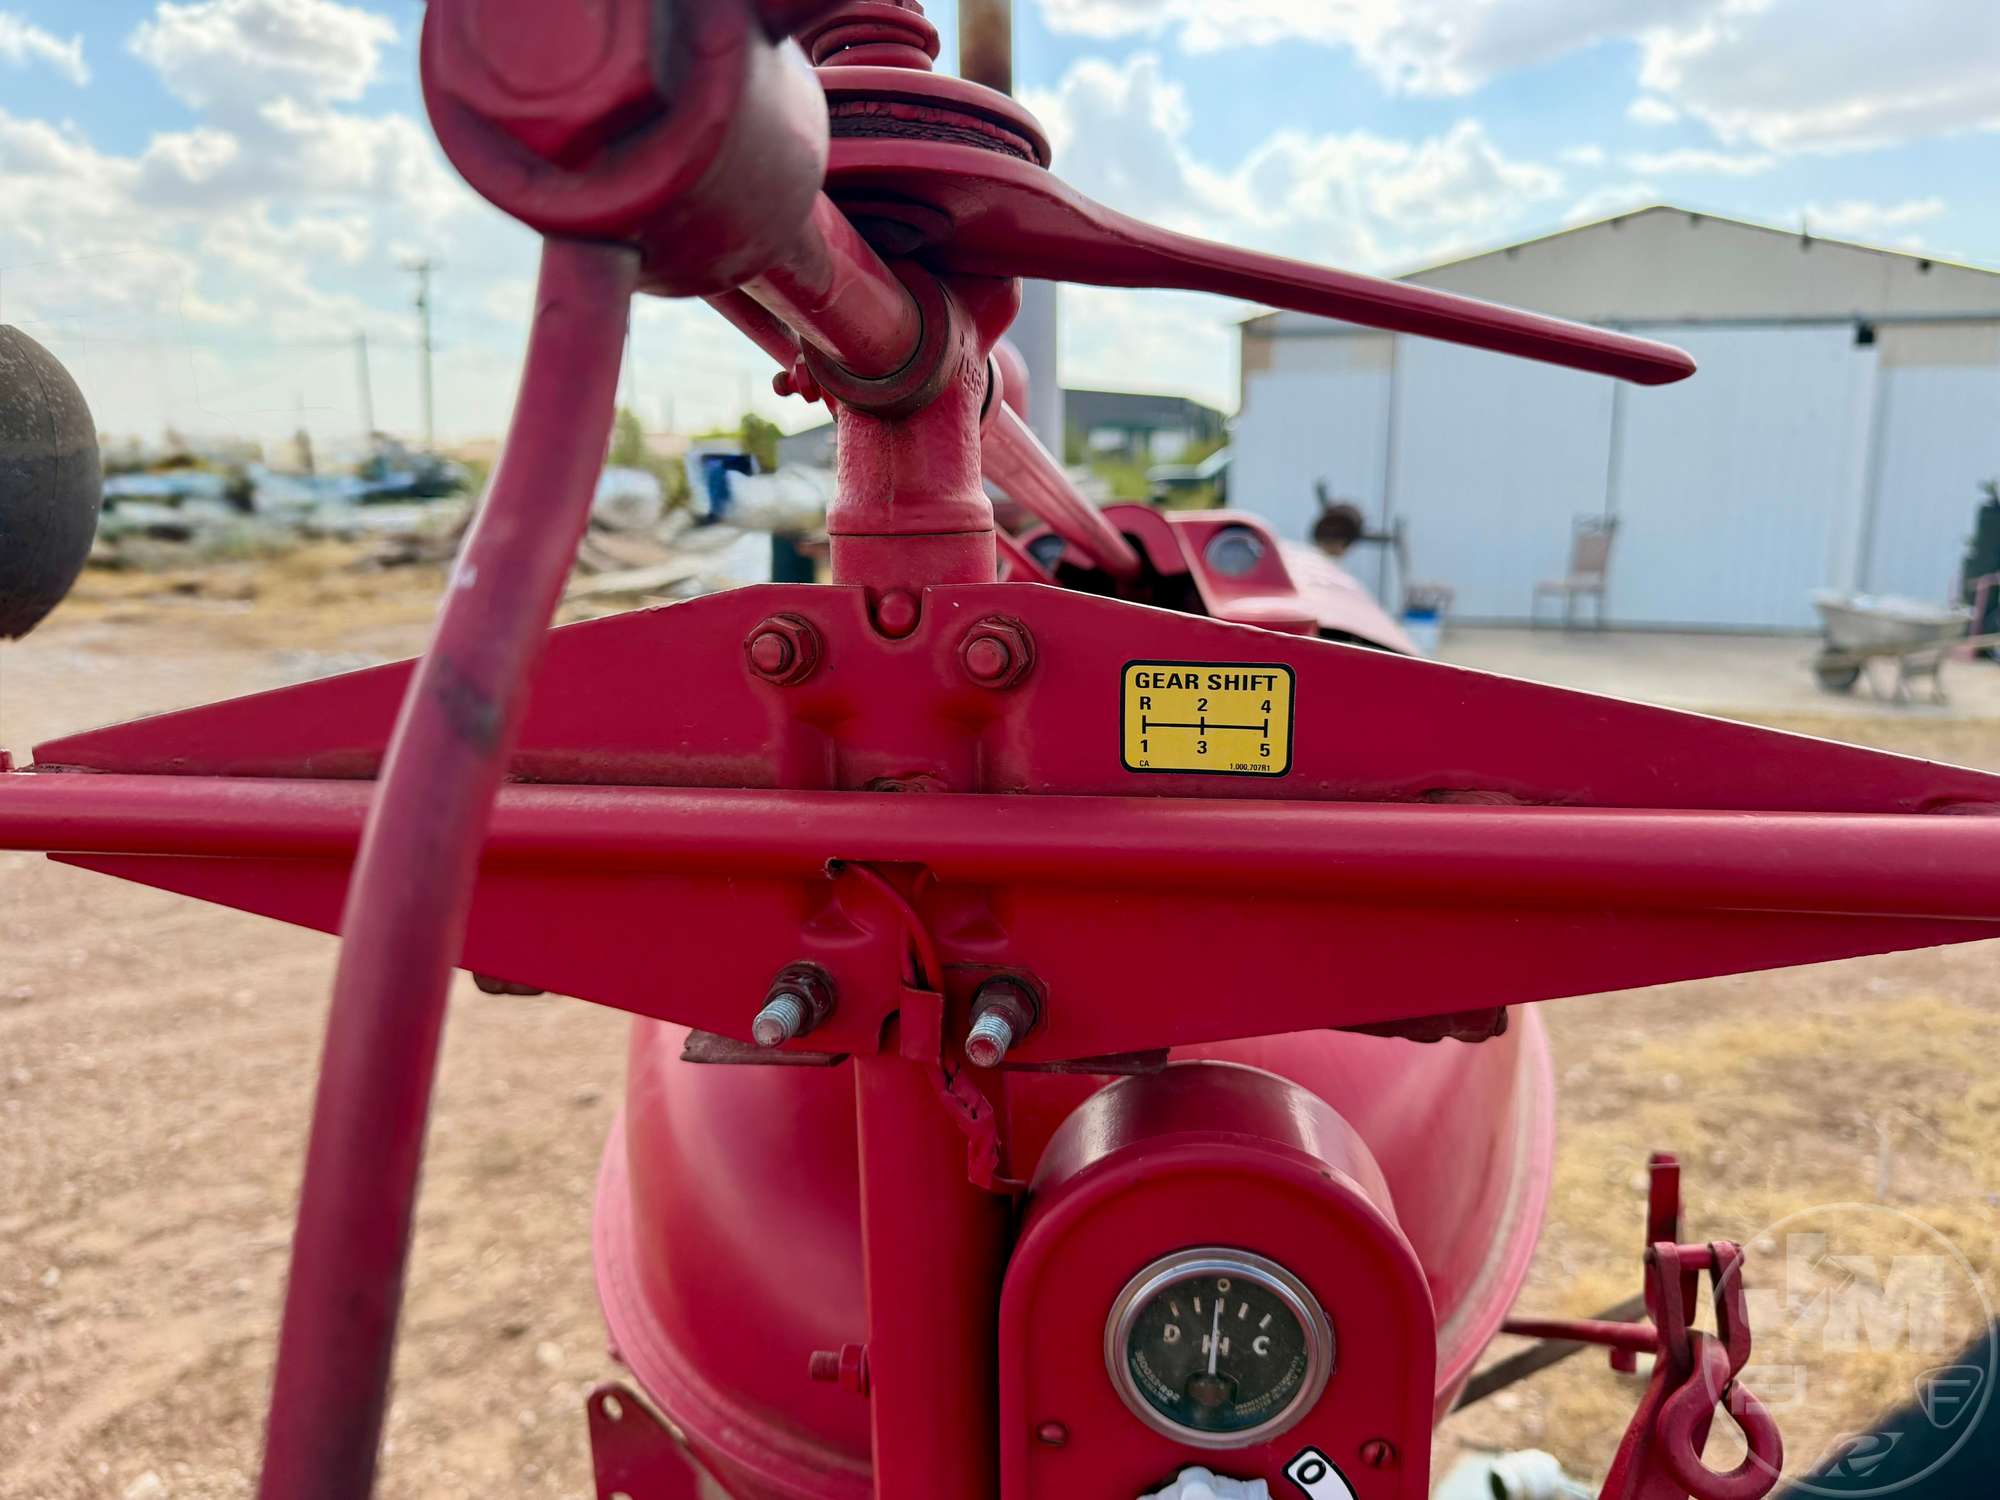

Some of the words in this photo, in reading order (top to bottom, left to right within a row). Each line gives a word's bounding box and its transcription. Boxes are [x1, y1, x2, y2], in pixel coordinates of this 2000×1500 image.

[1135, 672, 1199, 690] GEAR
[1207, 674, 1278, 692] SHIFT
[1139, 696, 1151, 710] R
[1197, 698, 1208, 711] 2
[1261, 700, 1271, 713] 4
[1140, 739, 1148, 753] 1
[1196, 740, 1208, 754] 3
[1259, 743, 1270, 757] 5
[1163, 1324, 1181, 1344] D
[1252, 1335, 1271, 1356] C
